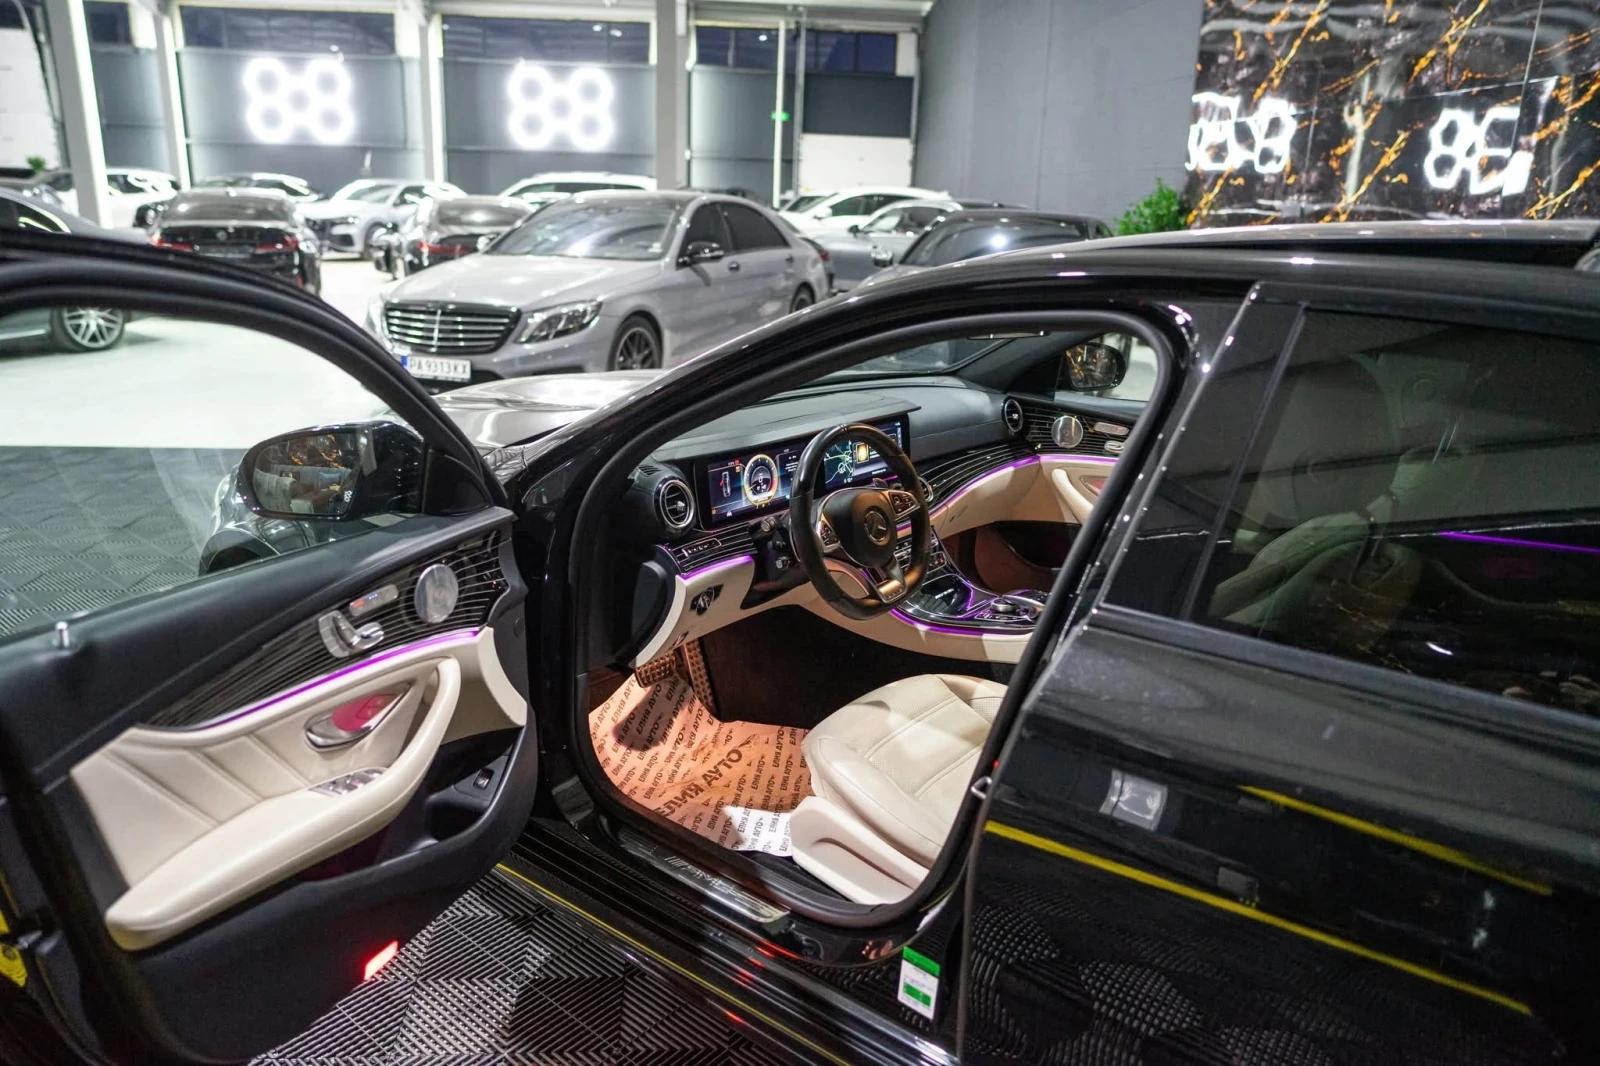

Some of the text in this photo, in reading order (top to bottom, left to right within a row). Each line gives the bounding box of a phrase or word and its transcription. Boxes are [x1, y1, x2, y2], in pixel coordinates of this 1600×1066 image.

[611, 700, 626, 723] ЕЛИЯ
[636, 684, 662, 734] ЕЛИЯ АУТО
[672, 694, 684, 718] АУТО
[693, 709, 703, 732] АУТО
[611, 712, 636, 753] ЕЛИЯ АУТО
[647, 722, 659, 744] АУТО
[620, 748, 632, 764] АУТО
[772, 730, 784, 768] ЕЛИЯ АУТО
[652, 749, 742, 818] ЕЛИЯ АУТО
[737, 777, 746, 792] АУТО
[751, 759, 765, 790] ЕЛИЯ АУТО
[780, 760, 793, 791] ЕЛИЯ АУТО
[765, 779, 775, 795] АУТО
[707, 800, 724, 830] ЕЛИЯ АУТО
[737, 817, 748, 833] ЕЛИЯ
[721, 820, 732, 836] АУТО
[752, 821, 763, 837] АУТО
